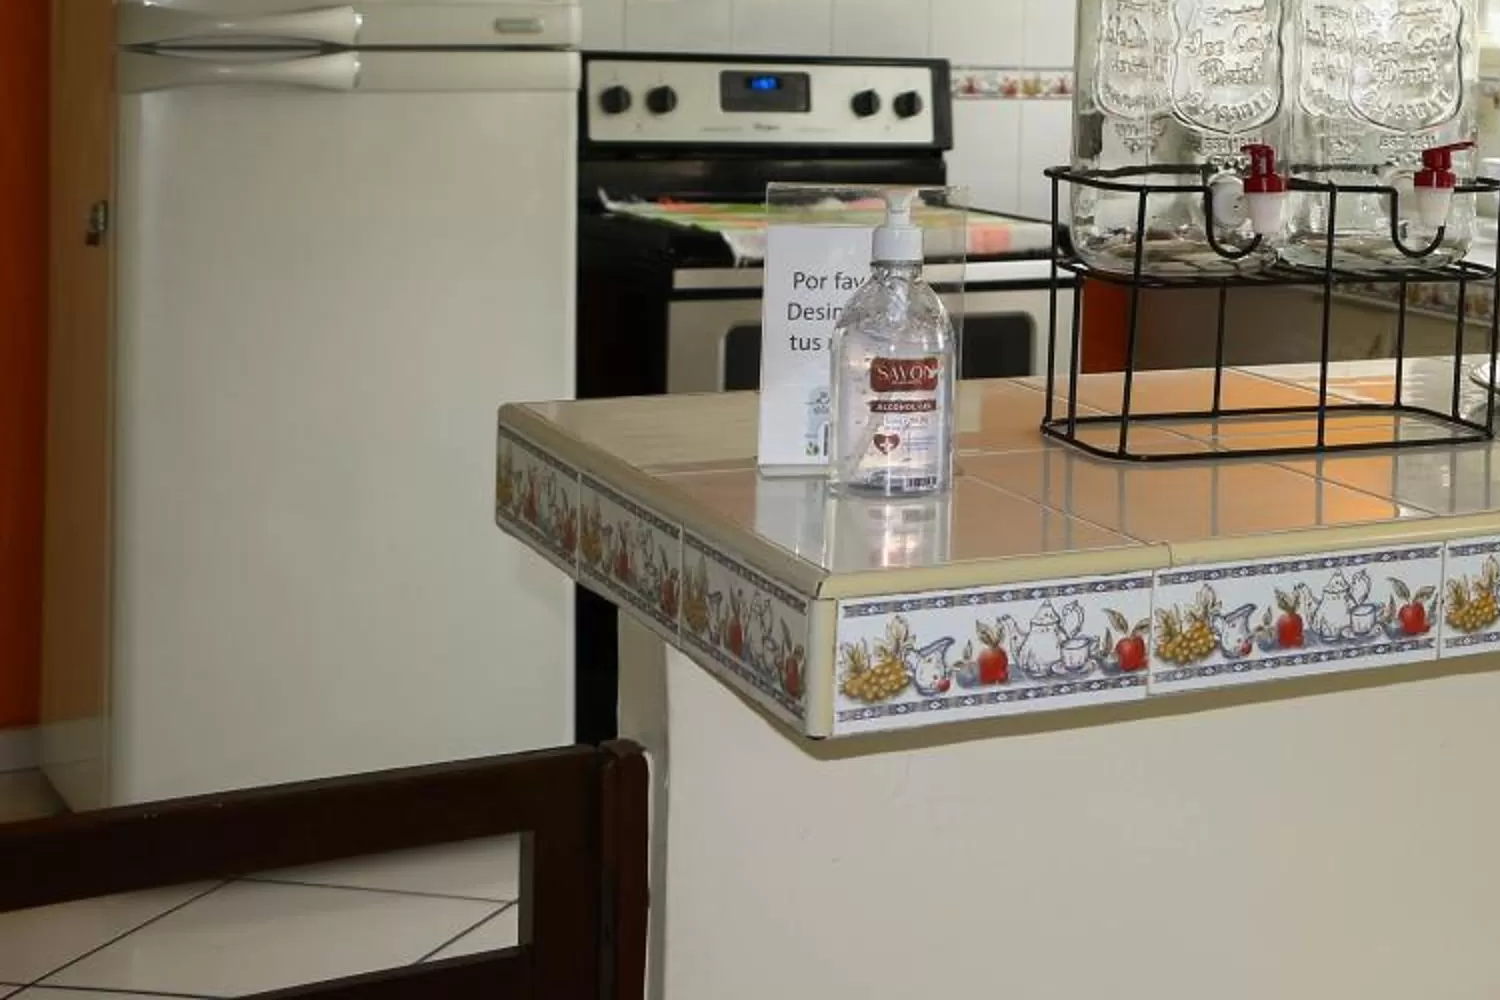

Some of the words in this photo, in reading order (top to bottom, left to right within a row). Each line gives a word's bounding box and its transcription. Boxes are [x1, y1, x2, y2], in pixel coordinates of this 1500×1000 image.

[793, 271, 828, 290] Por
[835, 271, 865, 290] fav
[787, 302, 844, 321] Desin
[789, 334, 822, 351] tus
